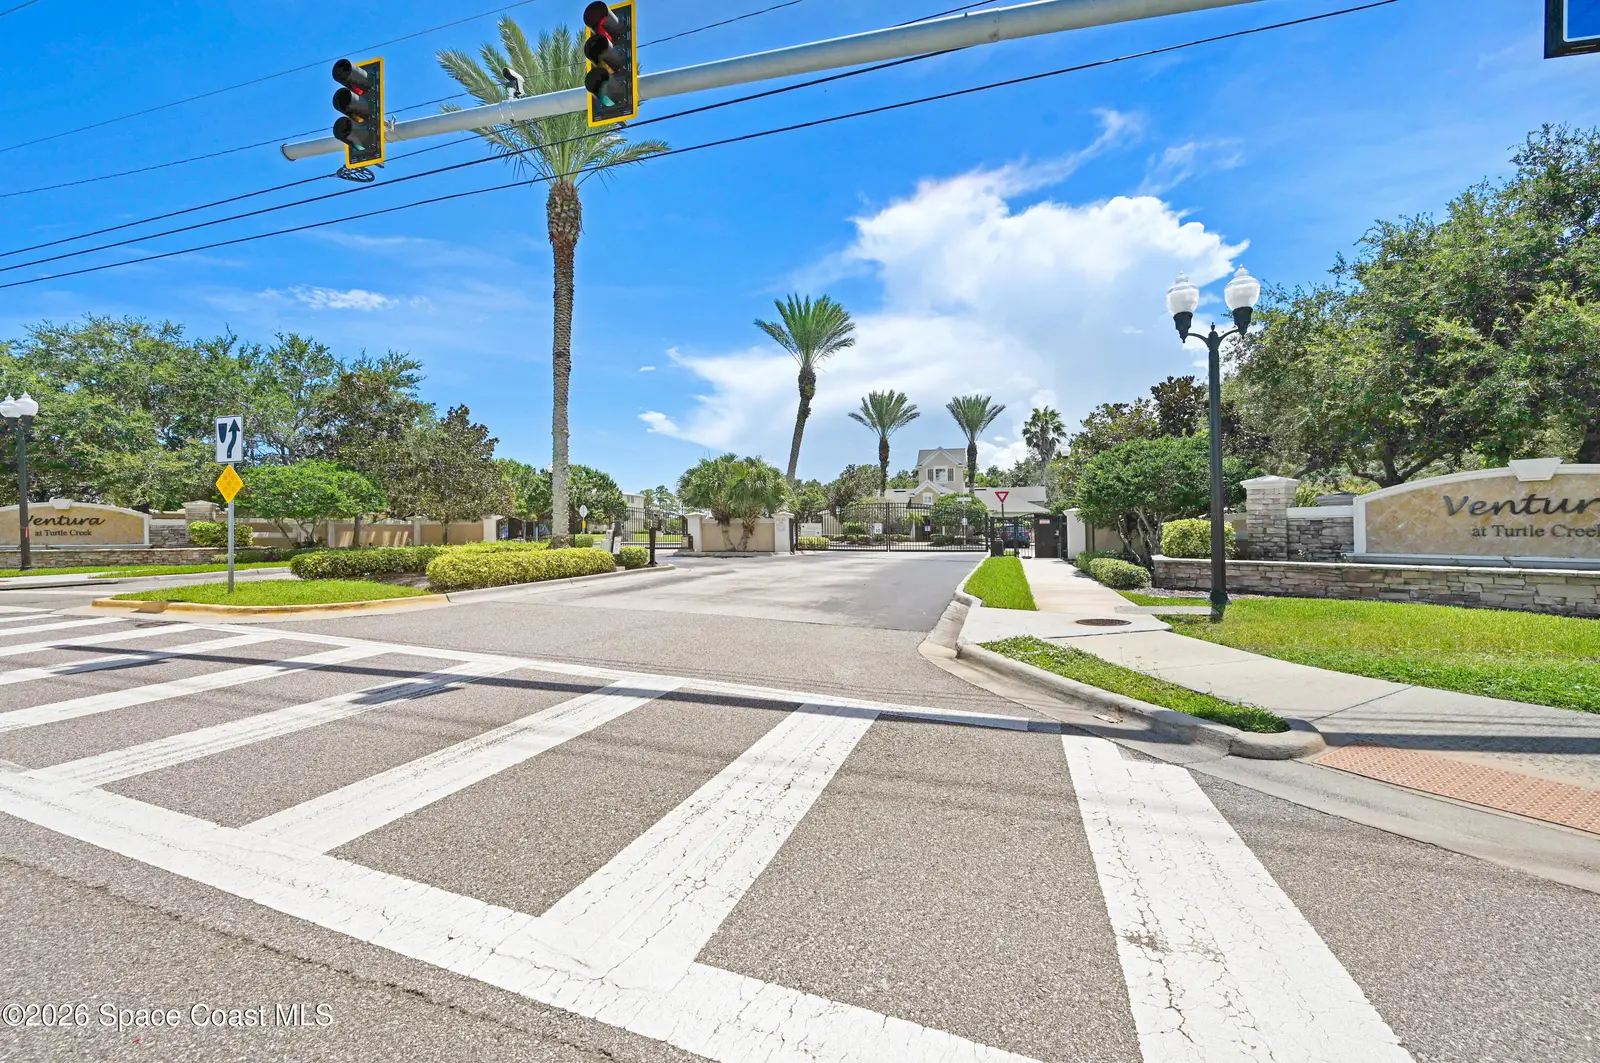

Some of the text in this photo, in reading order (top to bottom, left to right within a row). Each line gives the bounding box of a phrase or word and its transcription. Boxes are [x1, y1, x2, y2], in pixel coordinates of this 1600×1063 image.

[1443, 494, 1600, 517] Ventur
[44, 529, 68, 537] Turtle
[69, 529, 92, 537] Creek
[1472, 526, 1487, 538] at
[1491, 524, 1545, 538] Turtle
